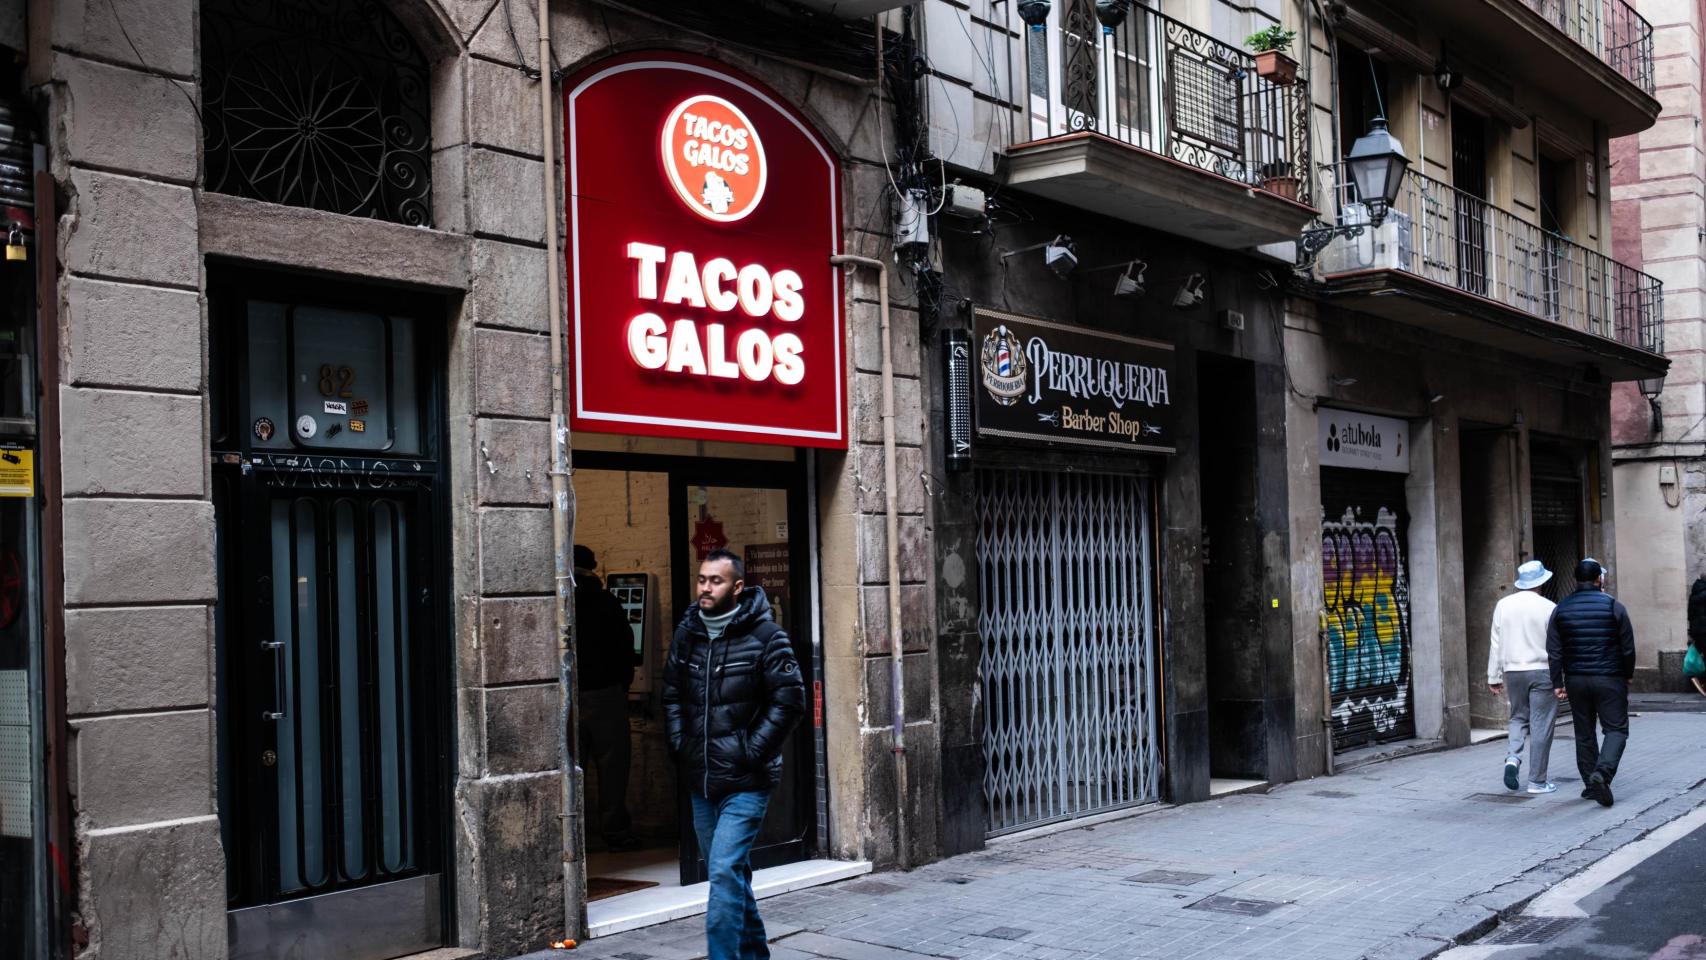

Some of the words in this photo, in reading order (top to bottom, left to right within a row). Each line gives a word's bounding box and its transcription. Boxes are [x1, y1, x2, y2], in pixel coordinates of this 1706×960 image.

[683, 112, 748, 150] TACOS
[683, 139, 749, 175] GALOS
[627, 241, 805, 322] TACOS
[627, 312, 805, 385] GALOS
[319, 363, 353, 399] 82
[1026, 336, 1170, 409] PERRUQUERIA
[1062, 405, 1106, 433] Barber
[1108, 411, 1140, 442] Shop
[1341, 422, 1382, 448] atubola
